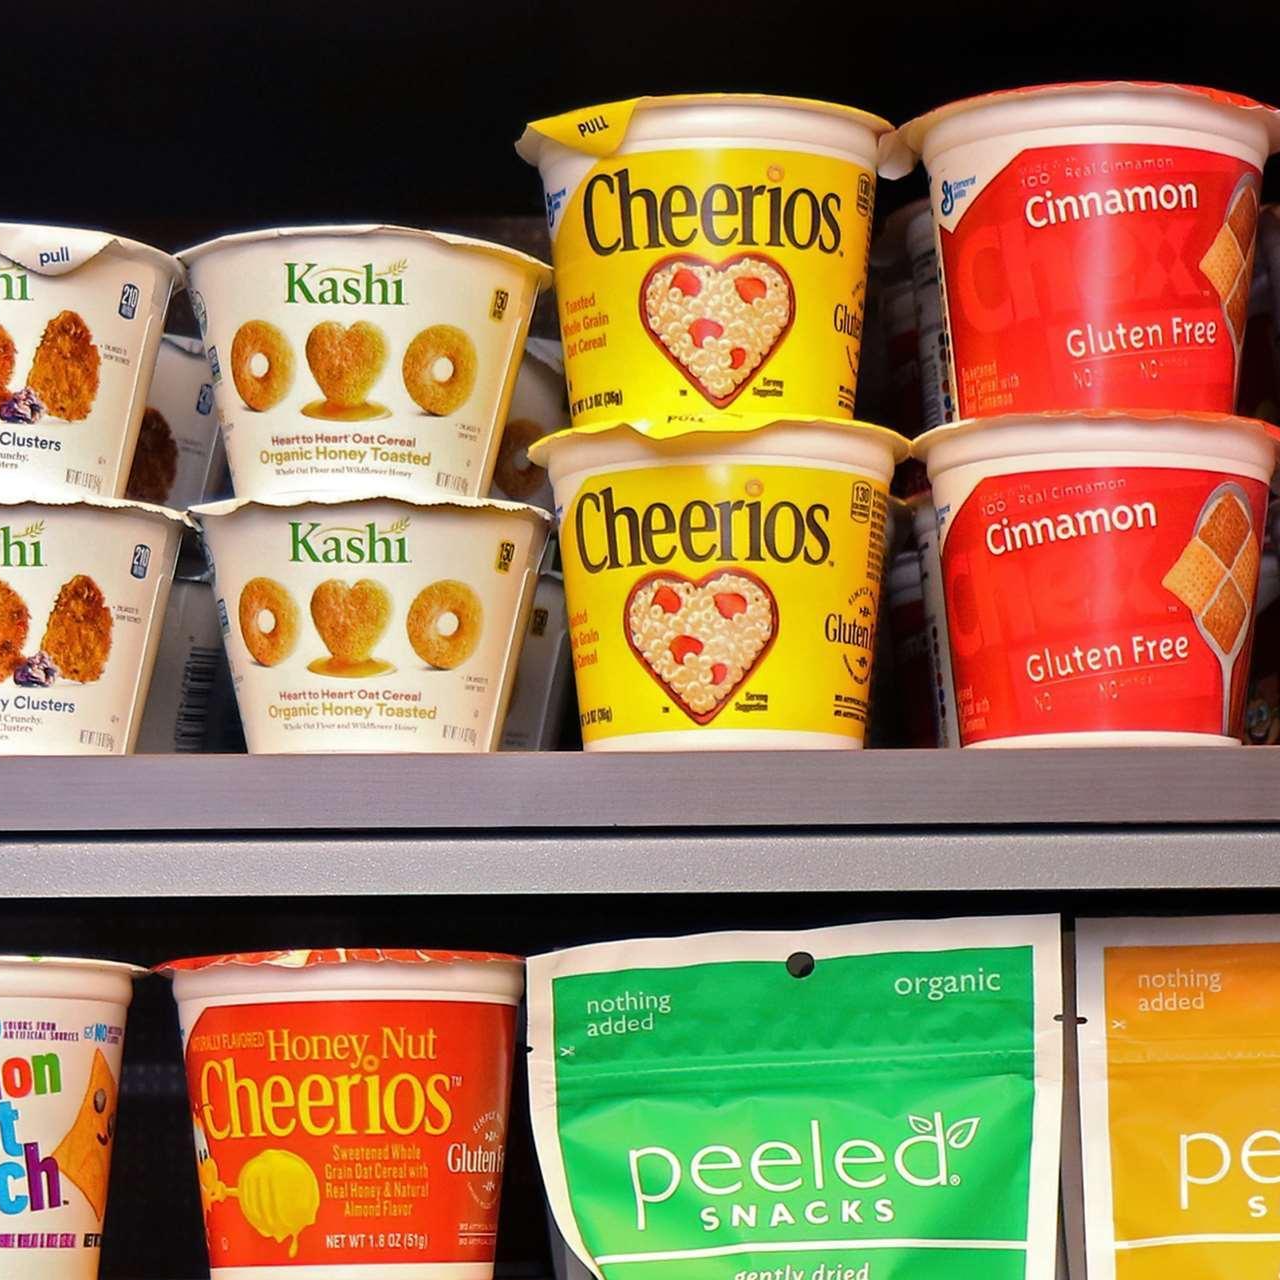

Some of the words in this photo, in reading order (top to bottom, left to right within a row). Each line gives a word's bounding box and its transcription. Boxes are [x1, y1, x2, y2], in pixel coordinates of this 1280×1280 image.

[577, 116, 608, 136] PULL
[583, 165, 841, 256] Cheerios
[1025, 183, 1198, 228] Cinnamon
[39, 247, 70, 267] pull
[284, 262, 405, 305] Kashi
[1066, 323, 1162, 358] Gluten
[1171, 316, 1217, 345] Free
[0, 432, 62, 452] Clusters
[377, 434, 416, 447] Cereal
[260, 447, 312, 464] Organic
[316, 446, 366, 463] Honey
[371, 447, 431, 465] Toasted
[575, 486, 830, 574] Cheerios
[986, 501, 1157, 556] Cinnamon
[289, 522, 410, 563] Kashi
[1027, 644, 1122, 682] Gluten
[1132, 634, 1189, 664] Free
[14, 696, 75, 713] Clusters
[268, 704, 319, 720] Organic
[321, 702, 372, 719] Honey
[376, 703, 437, 720] Toasted
[894, 968, 1001, 1001] organic
[1137, 968, 1221, 992] nothing
[587, 991, 672, 1016] nothing
[1137, 993, 1205, 1012] added
[587, 1013, 653, 1038] added
[267, 1028, 370, 1069] Honey
[381, 1026, 438, 1060] Nut
[200, 1058, 453, 1140] Cheerios
[332, 1145, 389, 1161] Sweetened
[392, 1145, 421, 1160] Whole
[325, 1164, 352, 1180] Grain
[374, 1164, 408, 1178] Cereal
[628, 1112, 951, 1231] peeled
[325, 1183, 348, 1198] Real
[350, 1184, 382, 1201] Honey
[394, 1182, 429, 1198] Natural
[344, 1202, 381, 1216] Almond
[382, 1201, 413, 1216] Flavor
[701, 1199, 895, 1231] SNACKS
[326, 1235, 347, 1249] NET
[349, 1235, 366, 1249] WT
